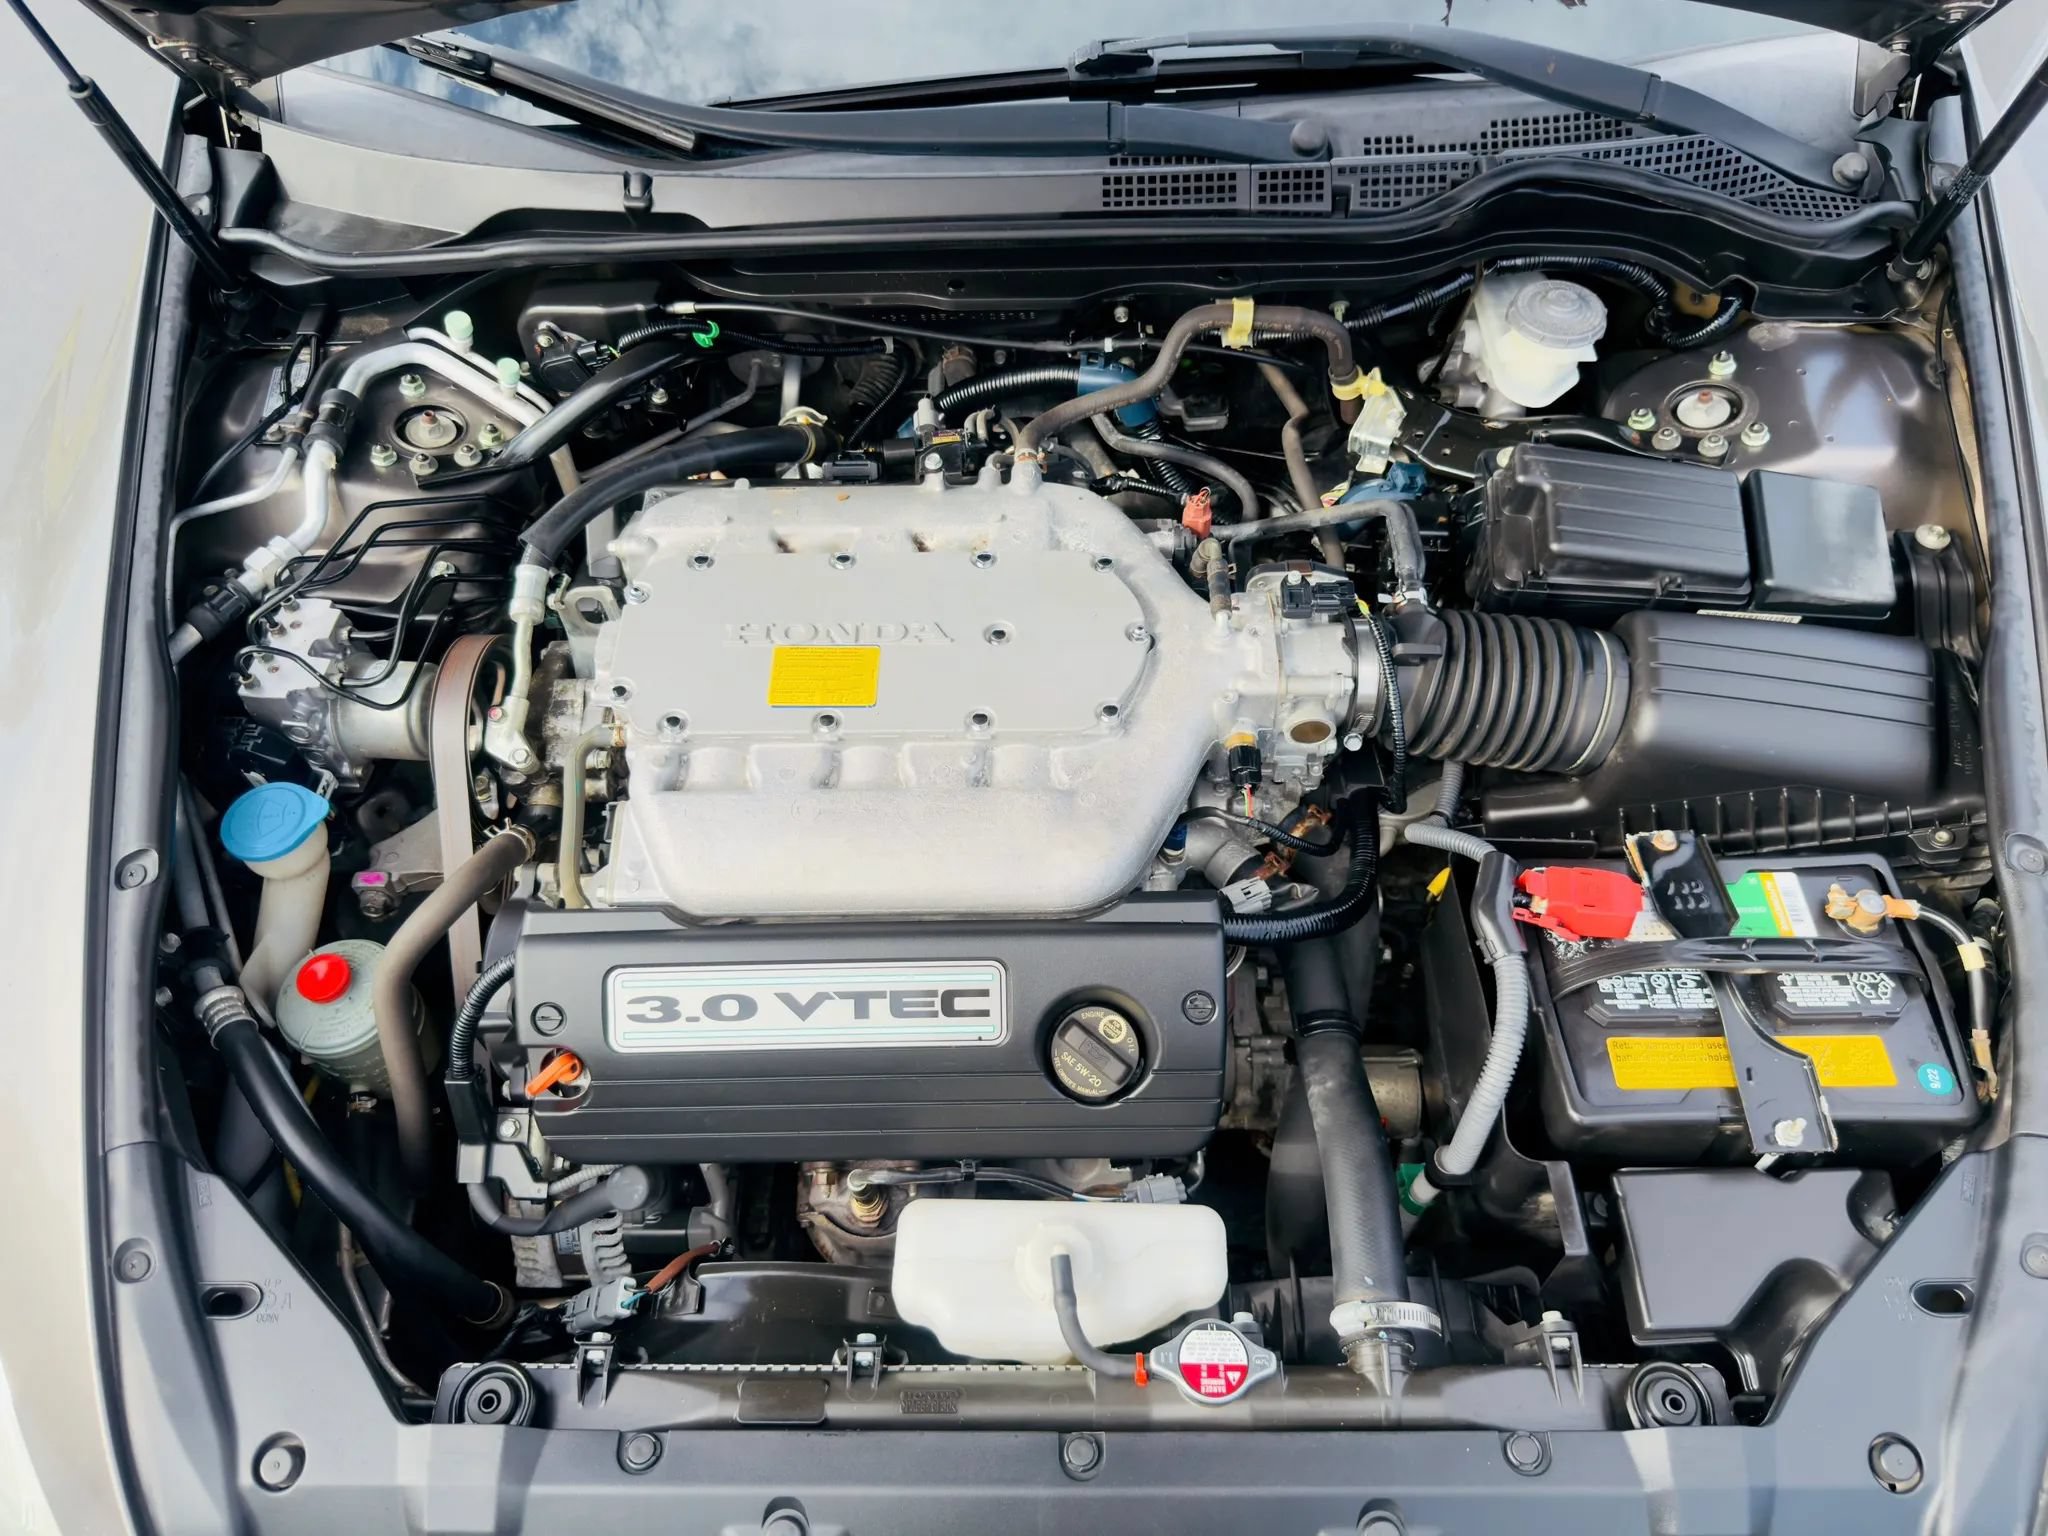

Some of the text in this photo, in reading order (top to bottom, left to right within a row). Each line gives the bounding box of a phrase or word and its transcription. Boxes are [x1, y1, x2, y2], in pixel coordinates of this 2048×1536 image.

[723, 622, 956, 645] HONDA
[626, 989, 990, 1024] 3.0 VTEC
[1081, 1011, 1136, 1054] ENGINE OIL
[1061, 1052, 1102, 1087] SAE 5W-20
[1927, 1068, 1941, 1090] 9/22
